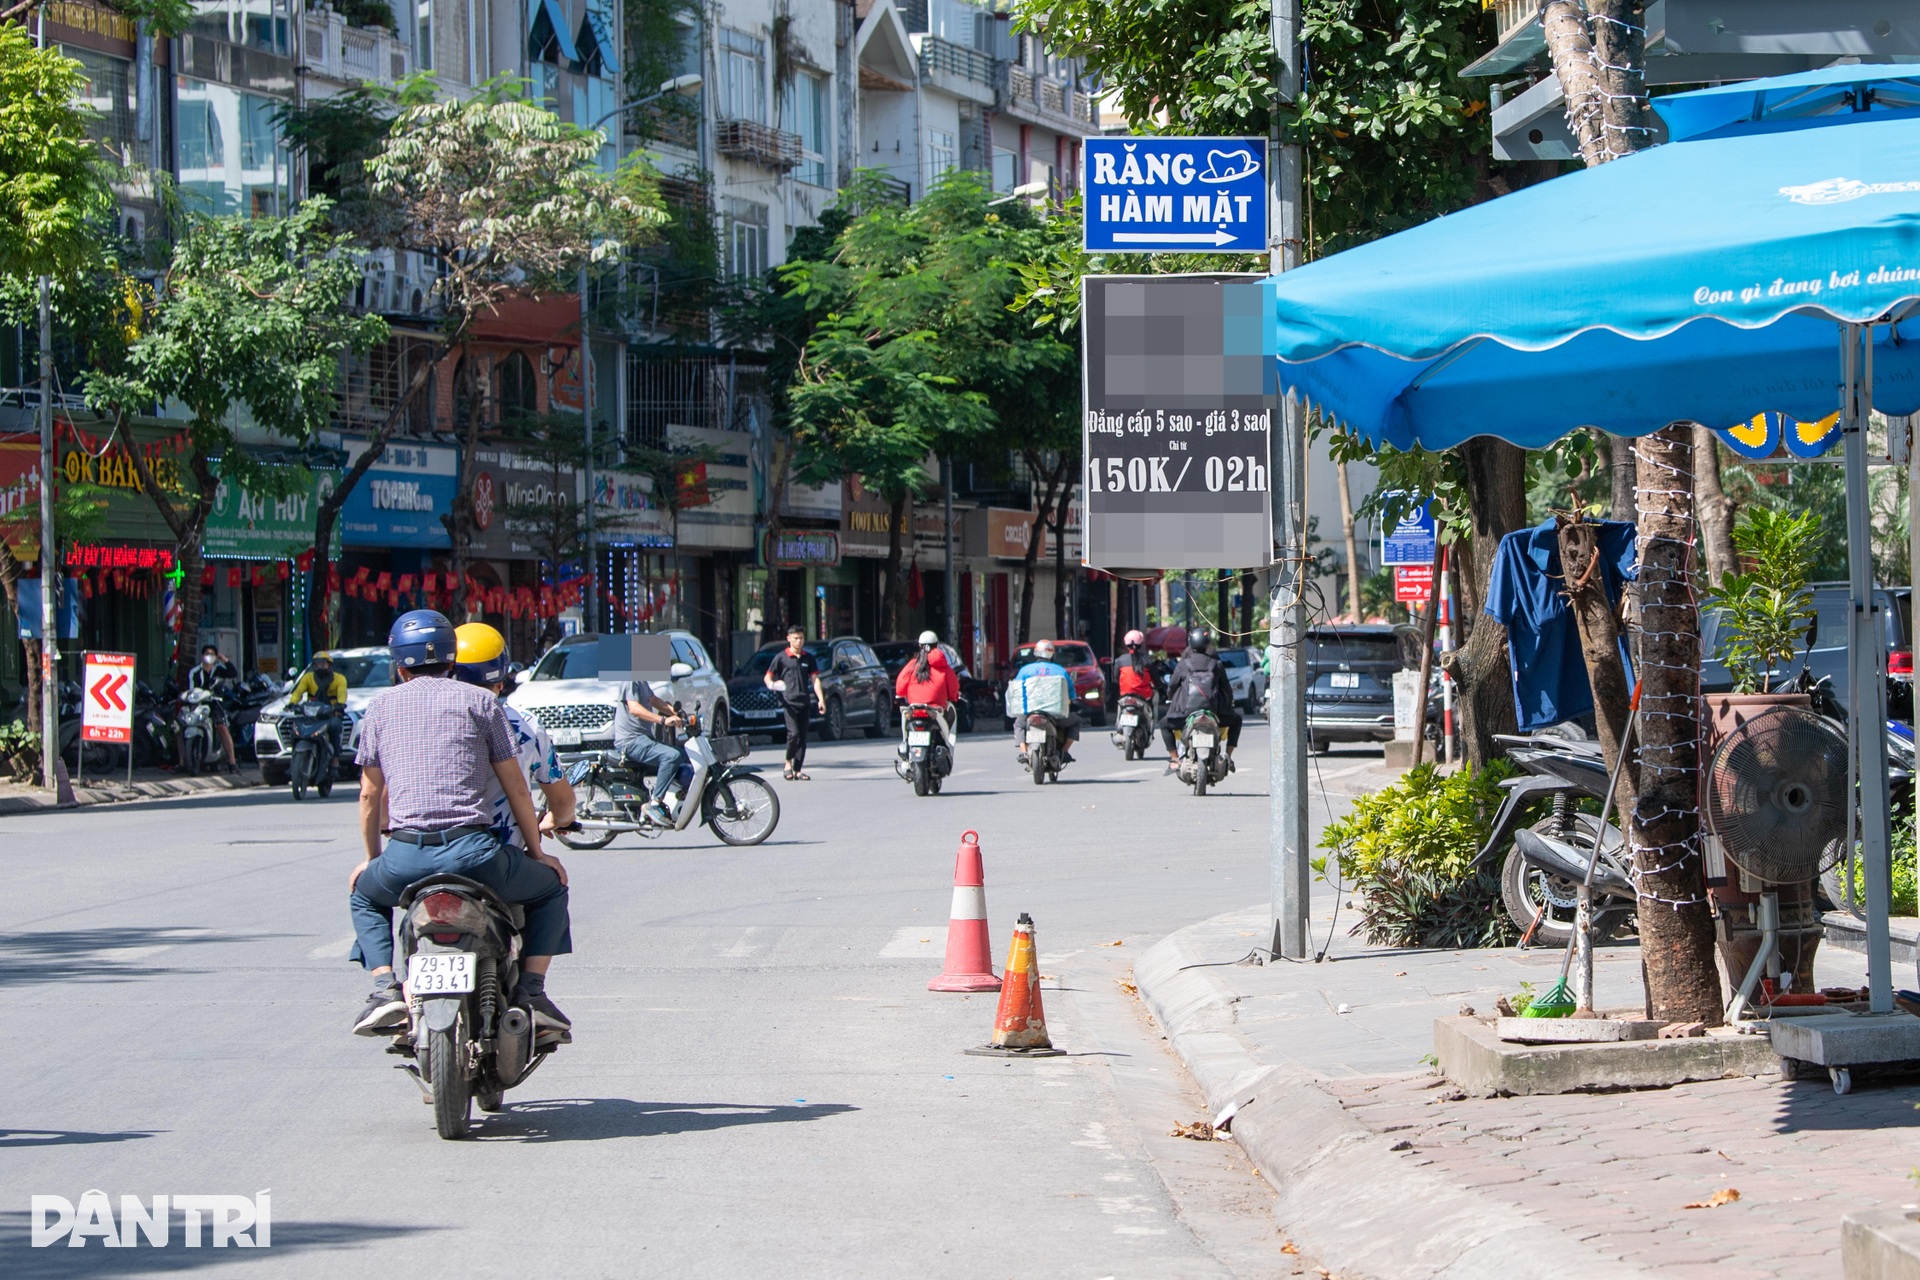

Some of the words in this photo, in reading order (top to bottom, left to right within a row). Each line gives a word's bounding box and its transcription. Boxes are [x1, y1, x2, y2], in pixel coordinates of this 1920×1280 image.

[1093, 143, 1196, 186] RĂNG
[1100, 190, 1172, 223] HÀM
[1183, 189, 1252, 229] MẶT
[1694, 286, 1735, 306] Con
[1740, 283, 1762, 304] gì
[1768, 277, 1822, 296] đang
[1829, 270, 1861, 290] bơi
[1127, 410, 1152, 436] cấp
[1156, 411, 1165, 433] 5
[1168, 415, 1193, 433] sao
[1205, 410, 1227, 437] giá
[1230, 410, 1240, 433] 3
[1243, 414, 1267, 432] sao
[65, 450, 94, 484] OK
[1089, 456, 1193, 493] 150K/
[1205, 456, 1268, 493] 02h
[1004, 525, 1022, 543] CIRCLE
[89, 728, 101, 738] 6h
[108, 729, 124, 739] 22h
[420, 956, 466, 974] 29-Y3
[414, 973, 469, 991] 433.41
